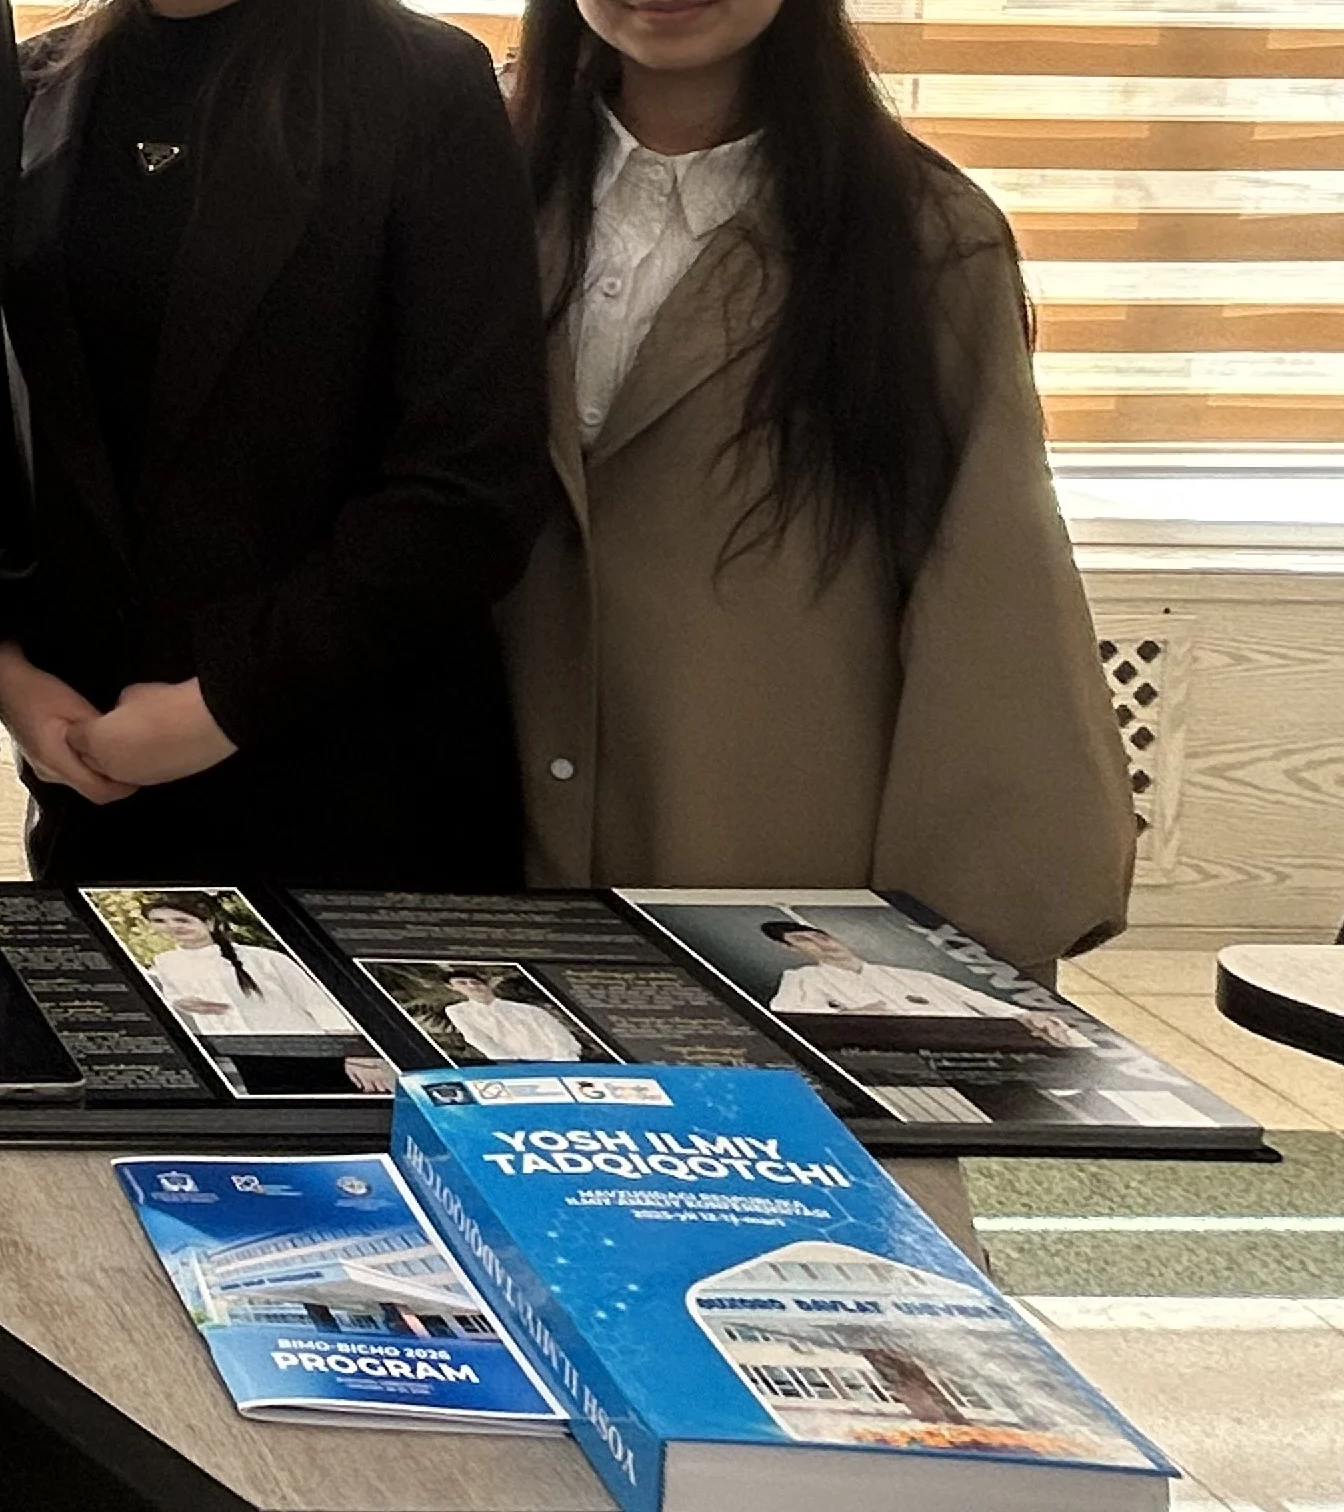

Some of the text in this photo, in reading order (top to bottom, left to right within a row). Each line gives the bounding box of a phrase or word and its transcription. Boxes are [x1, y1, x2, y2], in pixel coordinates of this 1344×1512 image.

[492, 1130, 783, 1160] YOSH ILMIY
[483, 1153, 852, 1188] TADQIQOTCHI
[270, 1352, 481, 1384] PROGRAM
[582, 1389, 638, 1487] YOSH
